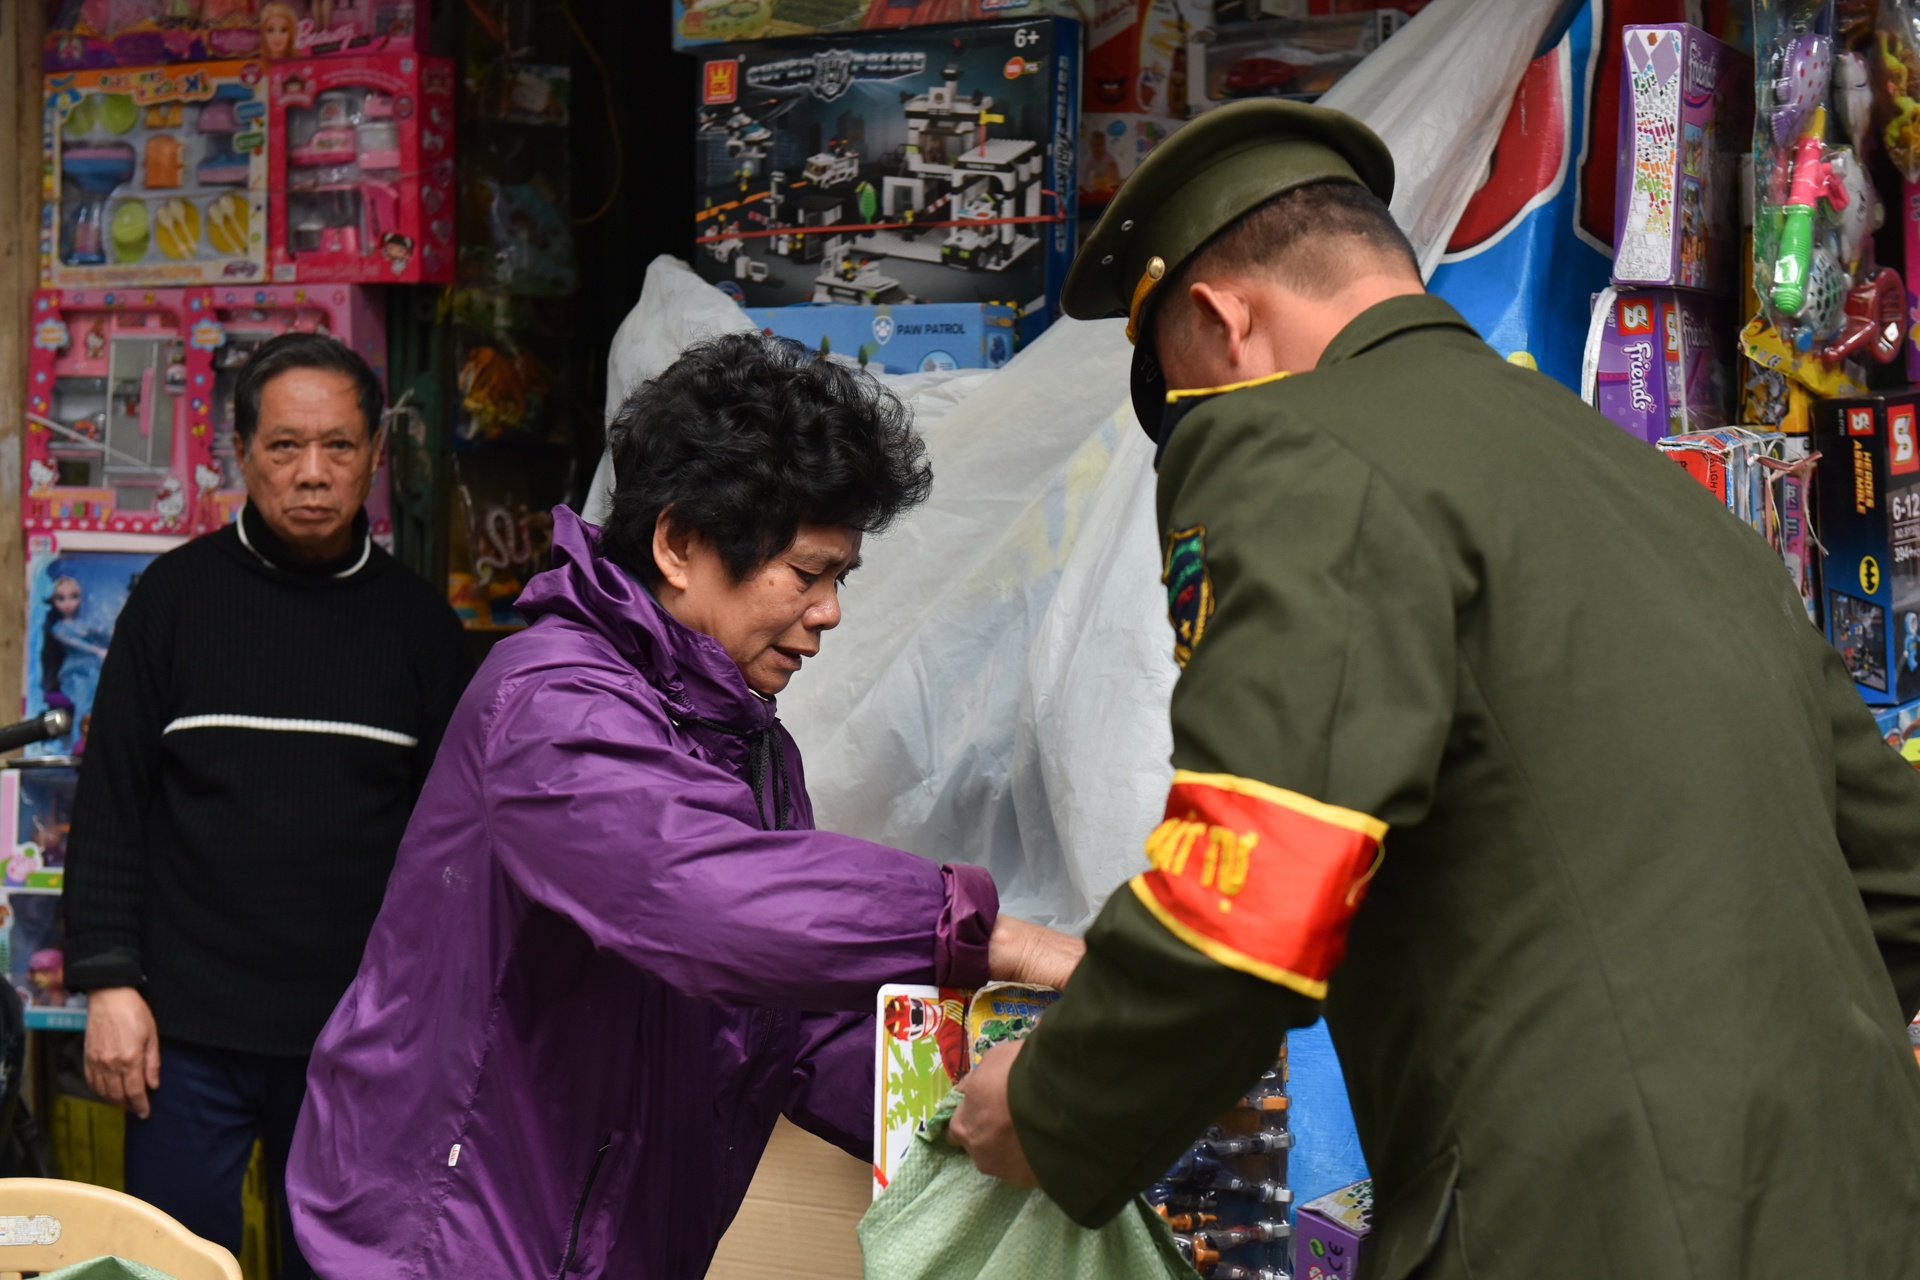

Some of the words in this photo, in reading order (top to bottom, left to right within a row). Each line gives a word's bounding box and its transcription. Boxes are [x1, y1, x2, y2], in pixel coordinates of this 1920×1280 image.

[1014, 28, 1040, 48] 6+
[897, 324, 922, 335] PAW
[925, 323, 966, 335] PATROL
[1622, 341, 1652, 411] Friends
[1852, 439, 1867, 515] ASSEMBLE
[1862, 451, 1875, 509] HEROES
[1893, 492, 1920, 521] 6-12
